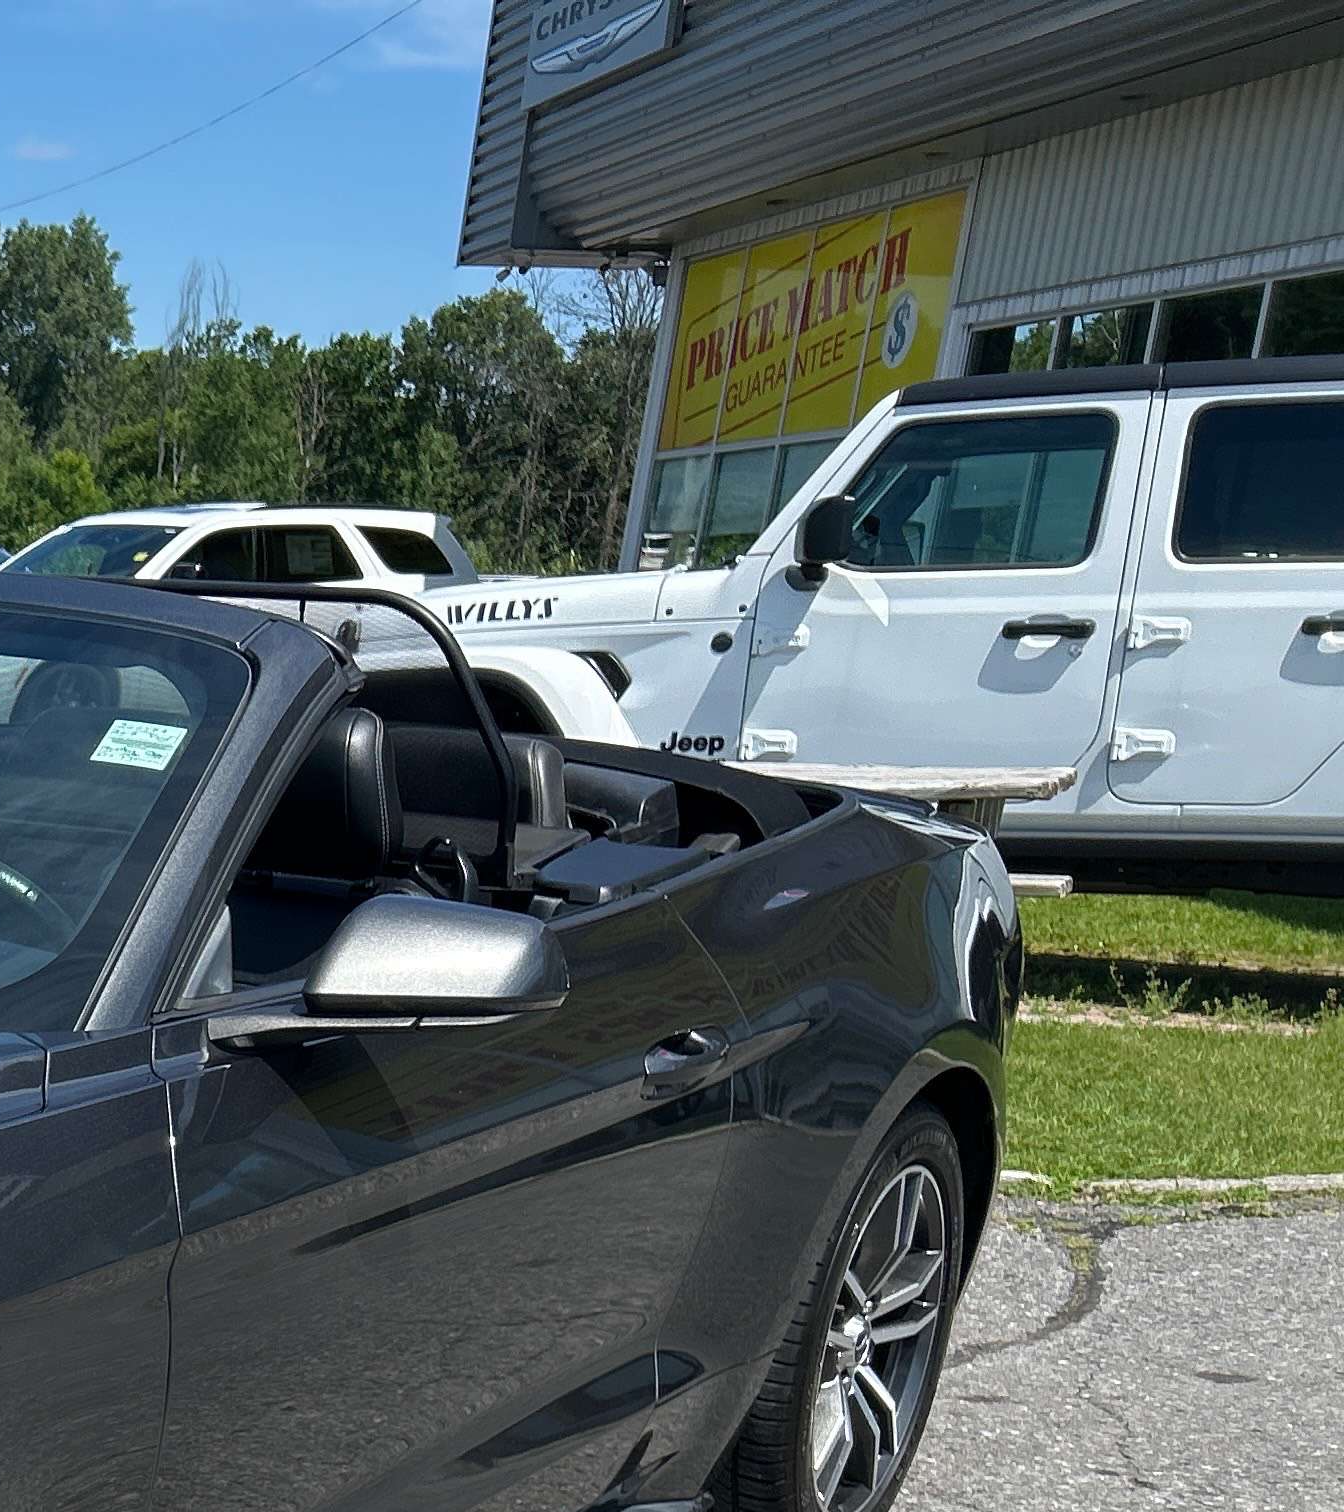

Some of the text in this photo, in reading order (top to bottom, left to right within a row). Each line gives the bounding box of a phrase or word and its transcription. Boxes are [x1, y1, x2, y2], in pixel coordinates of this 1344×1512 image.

[686, 227, 912, 392] PRICE MATCH
[725, 329, 848, 413] GUARANTEE
[447, 597, 559, 625] WILLYS
[660, 731, 725, 756] Jeep
